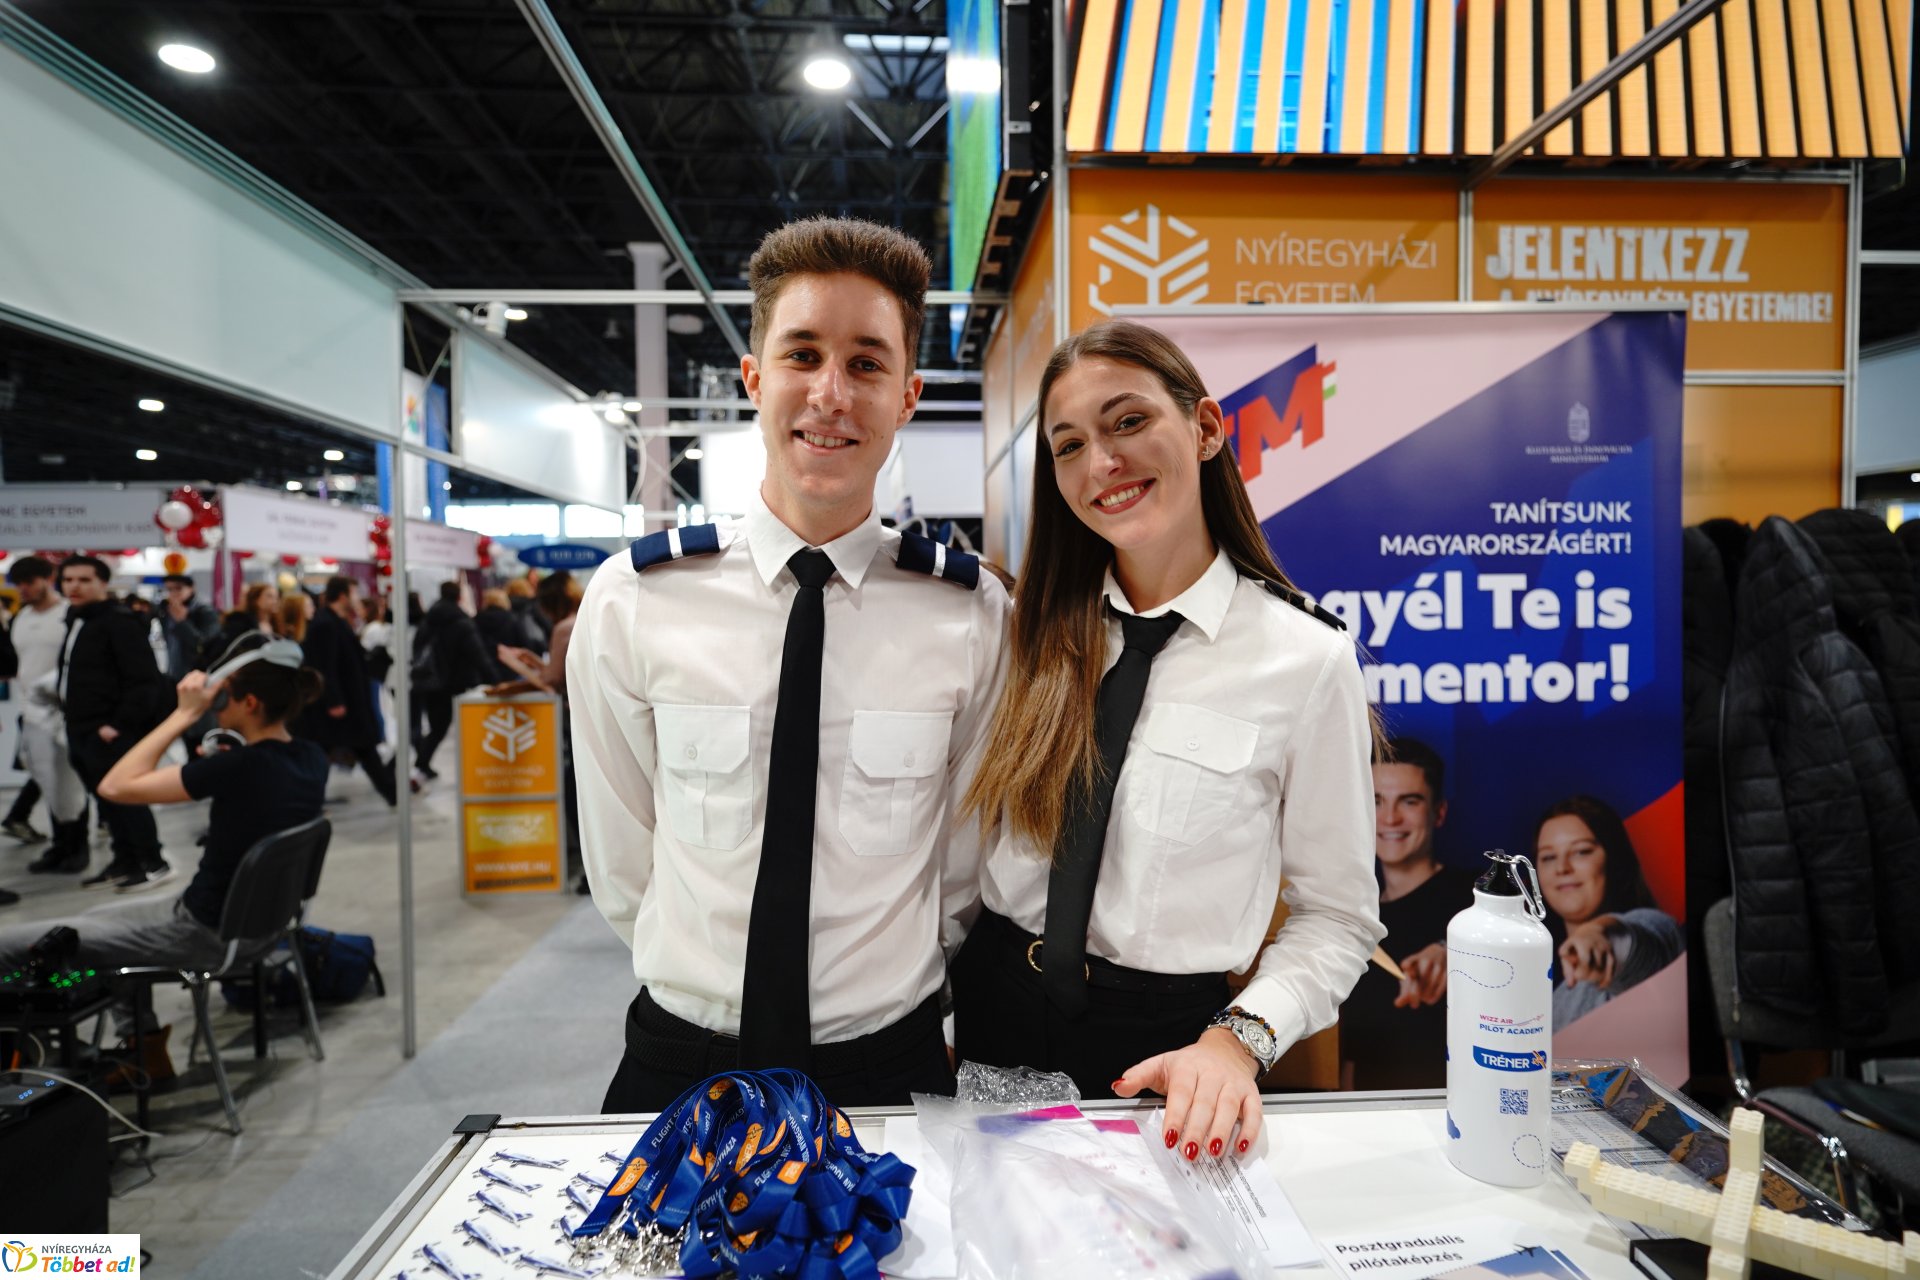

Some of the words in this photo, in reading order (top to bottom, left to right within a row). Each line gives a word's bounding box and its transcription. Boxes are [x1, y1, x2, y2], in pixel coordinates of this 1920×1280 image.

[1235, 232, 1438, 269] NYÍREGYHÁZI
[1486, 225, 1749, 283] JELENTKEZZ
[1692, 291, 1833, 322] EGYETEMRE!
[1489, 498, 1632, 524] TANÍTSUNK
[1380, 529, 1632, 556] MAGYARORSZÁGÉRT!
[1303, 571, 1463, 647] gyél
[1477, 573, 1561, 630] Te
[1575, 570, 1633, 629] is
[1362, 643, 1630, 704] mentor!
[1479, 1014, 1498, 1023] WIZZ
[1479, 1023, 1504, 1034] PILOT
[1507, 1026, 1544, 1035] ACADEMY
[1481, 1053, 1530, 1069] TRÉNER
[651, 1116, 675, 1148] FLIGHT
[1335, 1234, 1465, 1254] Posztgraduális
[1349, 1251, 1463, 1272] pilótaképzés
